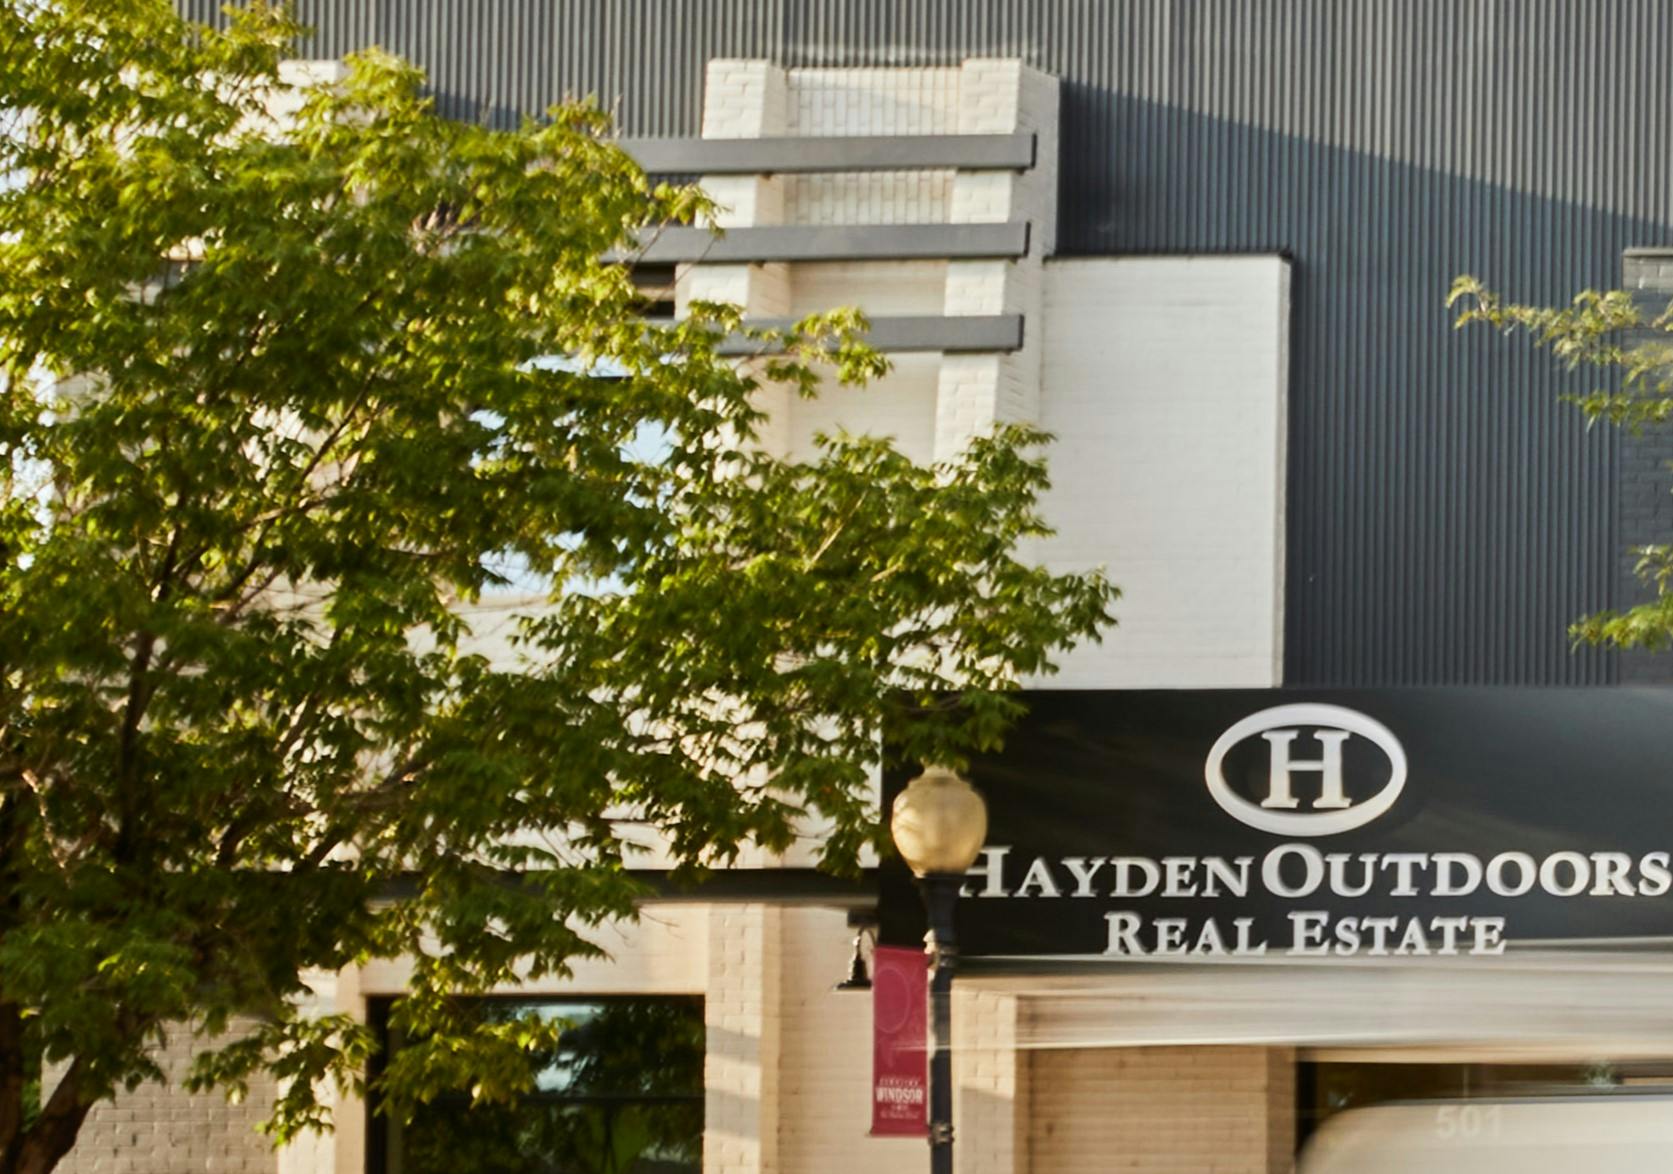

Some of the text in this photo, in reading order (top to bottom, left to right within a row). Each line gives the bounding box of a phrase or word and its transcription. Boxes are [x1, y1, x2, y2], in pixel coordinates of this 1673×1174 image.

[1260, 730, 1352, 809] H
[1102, 910, 1508, 957] REAL ESTATE
[1435, 1105, 1503, 1138] 501
